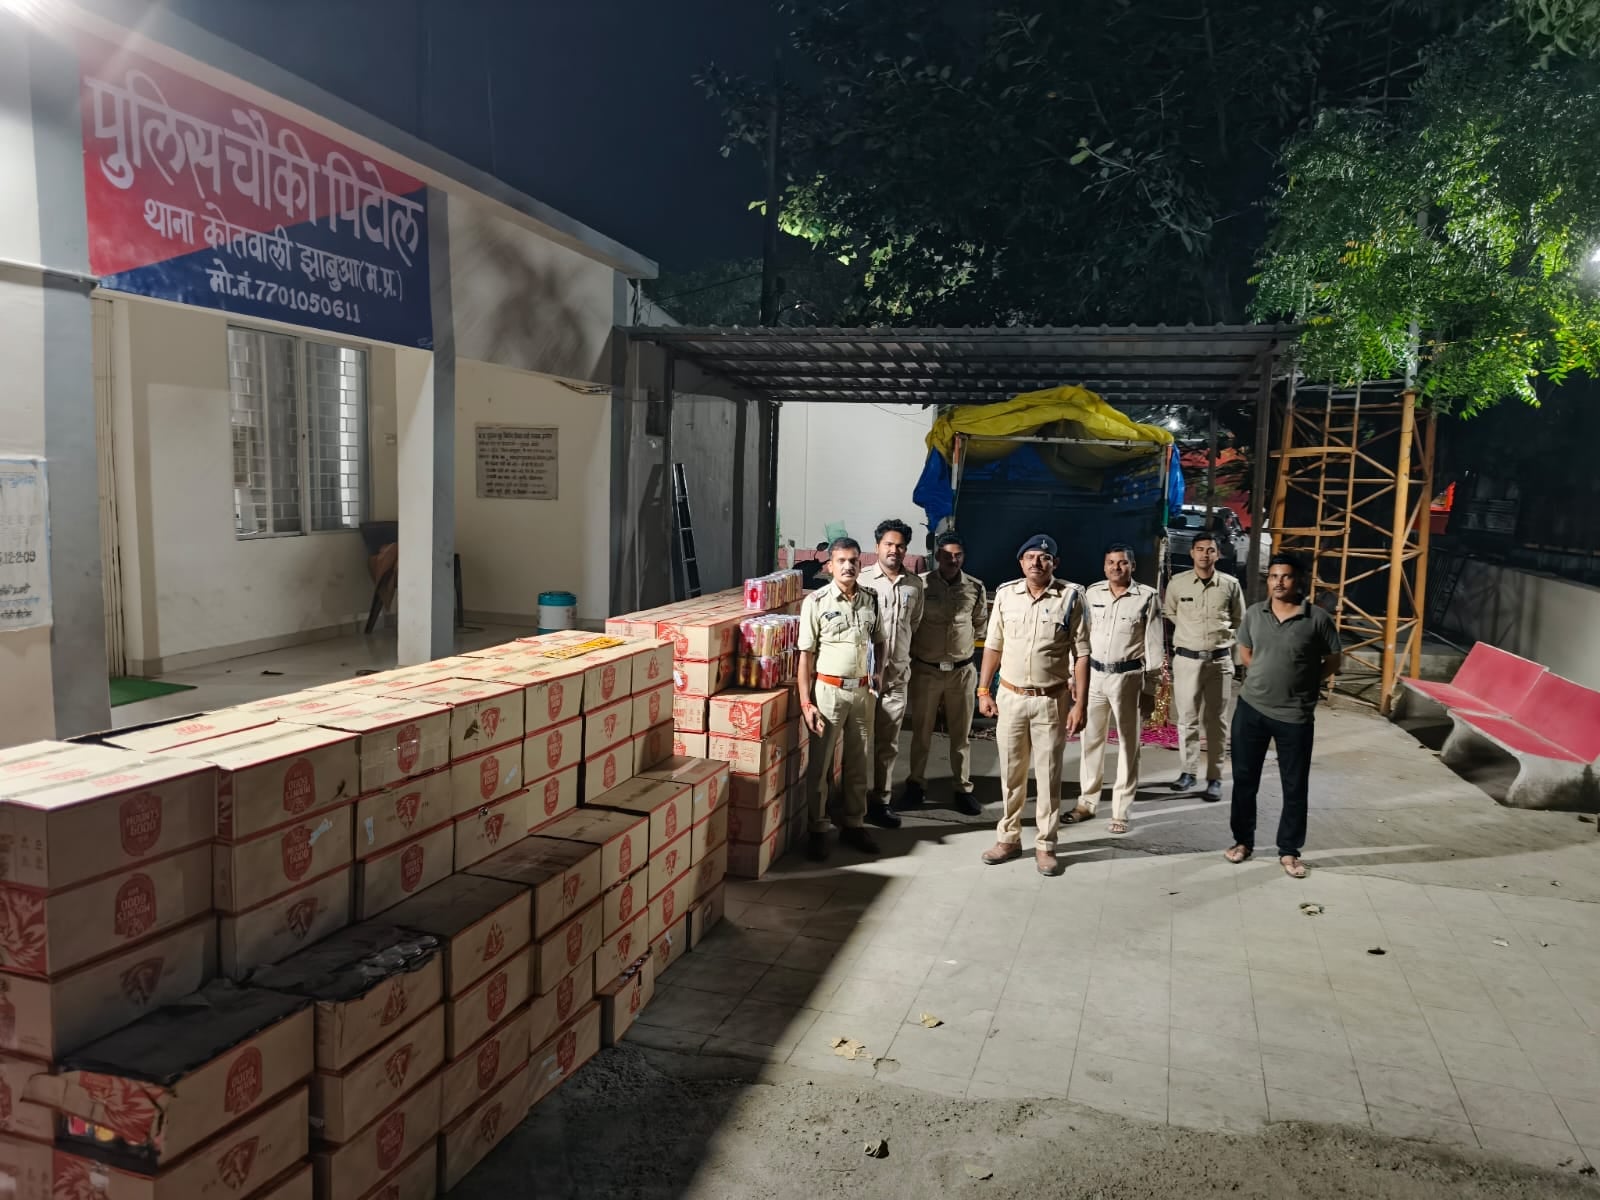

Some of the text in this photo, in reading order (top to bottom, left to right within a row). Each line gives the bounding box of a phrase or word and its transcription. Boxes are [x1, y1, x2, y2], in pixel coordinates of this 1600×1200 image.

[84, 69, 424, 267] पुलिस चौकी पिटोल
[144, 199, 195, 245] थाना
[201, 202, 293, 271] कोतवाली
